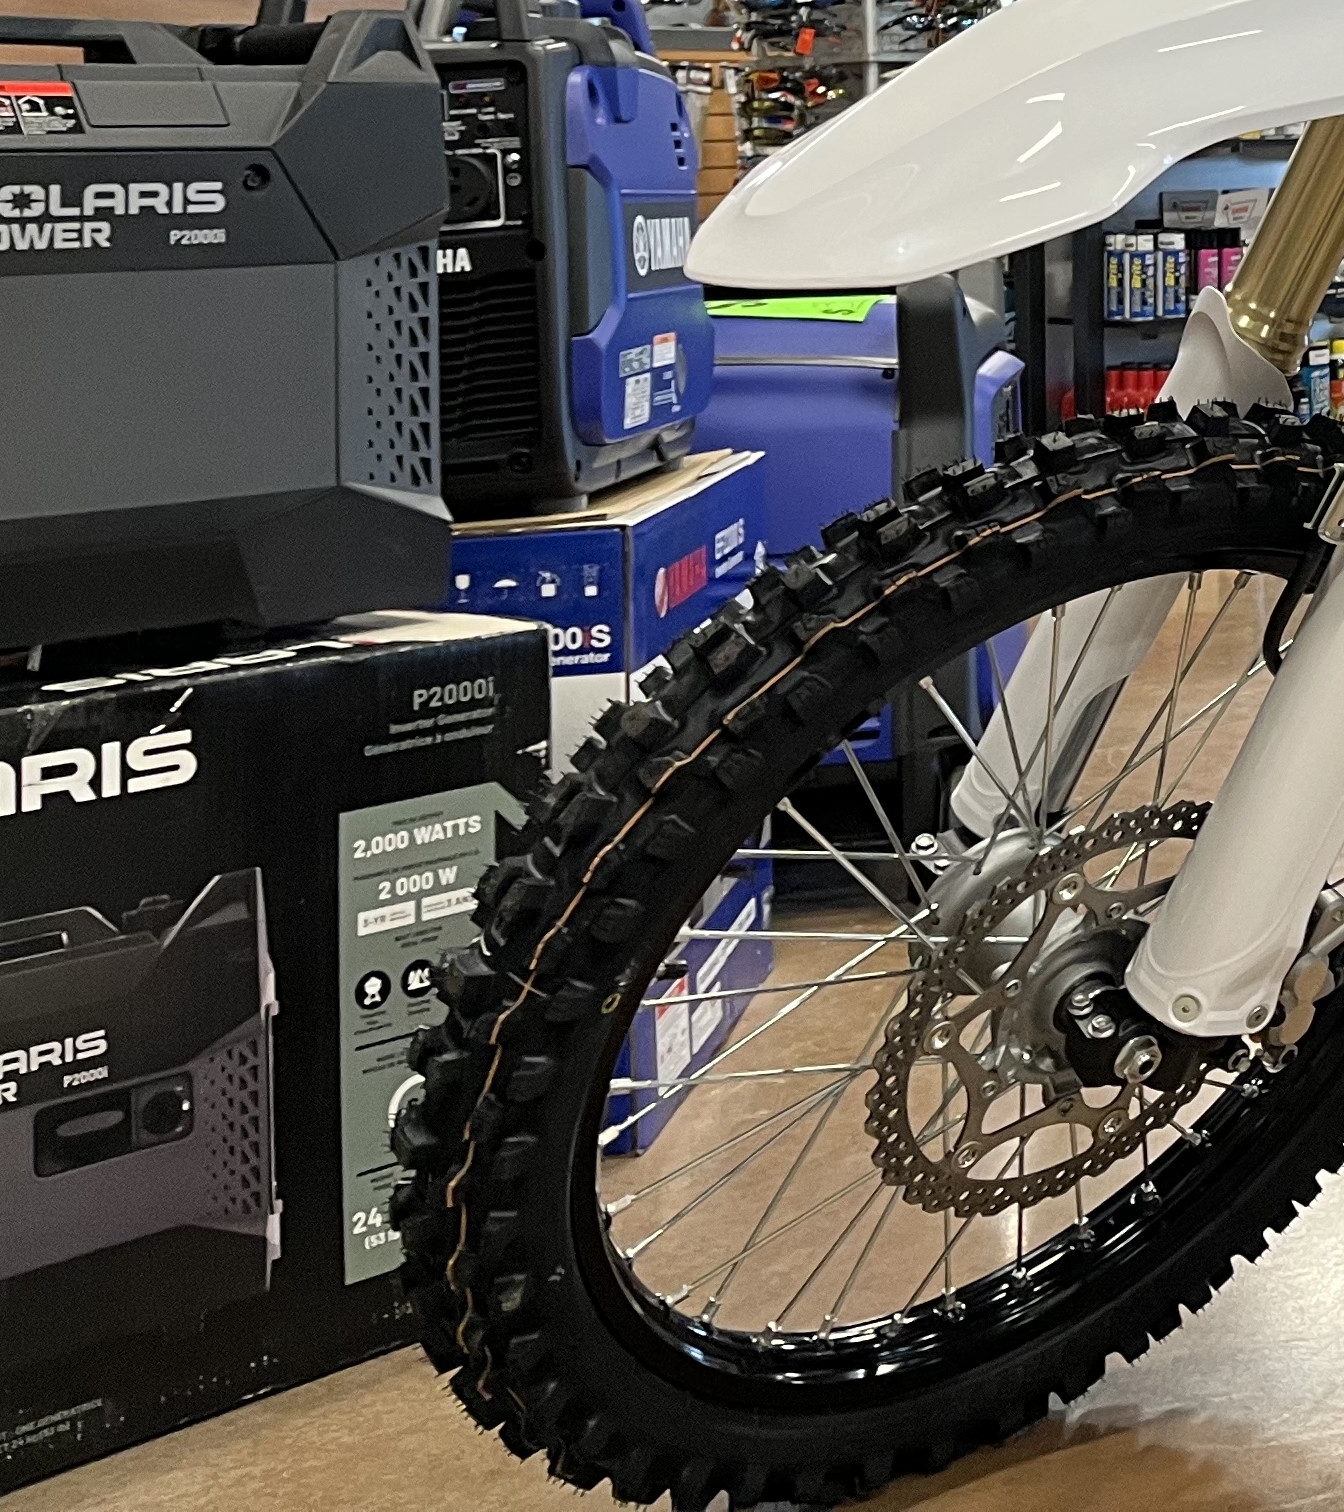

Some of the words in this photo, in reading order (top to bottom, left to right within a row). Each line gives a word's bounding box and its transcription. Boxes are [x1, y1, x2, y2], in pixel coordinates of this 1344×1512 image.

[436, 247, 473, 274] HA
[412, 676, 496, 711] P2000i
[0, 729, 198, 817] RIS
[353, 830, 410, 859] 2,000
[413, 815, 483, 845] WATTS
[378, 881, 392, 900] 2
[395, 871, 434, 896] 000
[438, 865, 458, 886] W
[352, 1206, 383, 1235] 24
